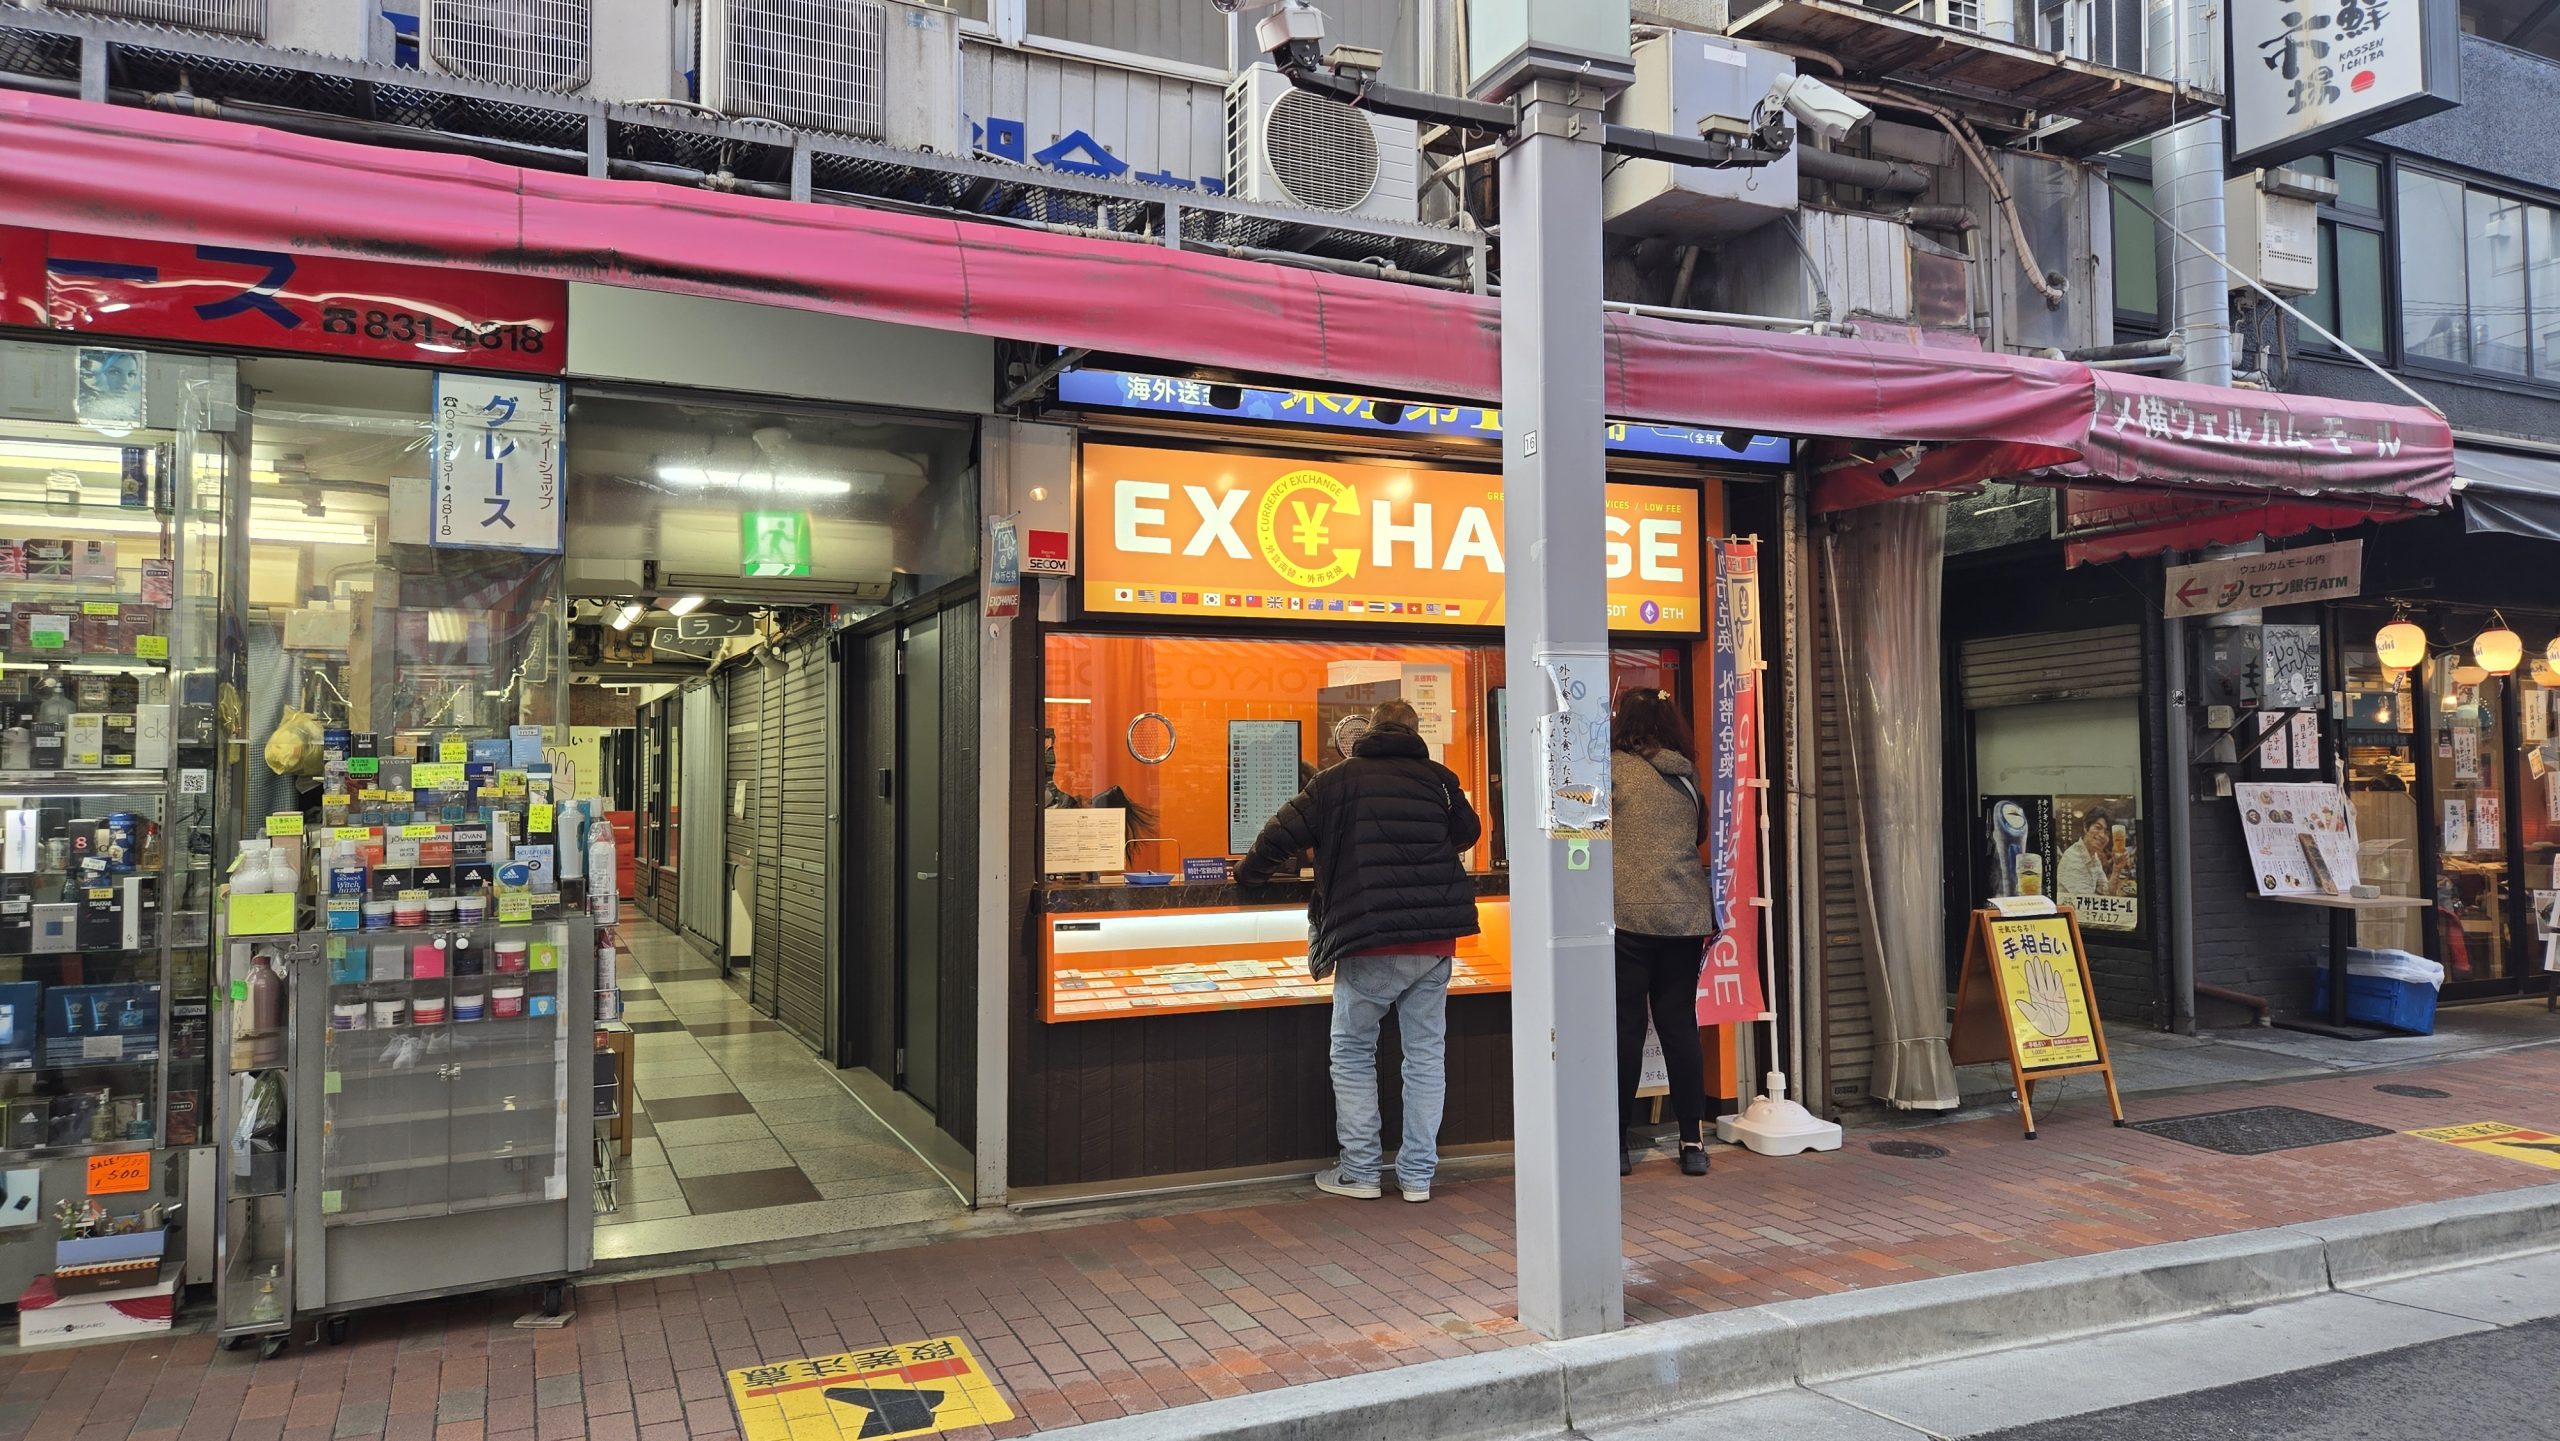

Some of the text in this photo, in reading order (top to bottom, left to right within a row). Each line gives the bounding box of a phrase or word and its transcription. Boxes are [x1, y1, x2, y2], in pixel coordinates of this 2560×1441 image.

[2338, 37, 2384, 62] KASSEN
[2341, 49, 2385, 72] ICHIBA
[1525, 436, 1536, 450] 16
[480, 394, 519, 530] グレース
[1261, 474, 1343, 532] CURRENCY EXCHANGE
[1644, 503, 1663, 513] LOW
[1666, 505, 1681, 513] FEE
[1029, 558, 1067, 570] SECOM
[1662, 606, 1684, 620] ETH
[74, 728, 94, 744] ck
[143, 718, 167, 739] ck
[75, 836, 88, 849] 8
[458, 833, 483, 841] JOVAN
[336, 881, 360, 889] Witch
[338, 885, 361, 894] hazel
[2076, 896, 2133, 913] アサヒ生ビール
[2091, 912, 2119, 922] マルエフ
[2002, 933, 2068, 959] 手相占い
[742, 1340, 956, 1388] 段差注意
